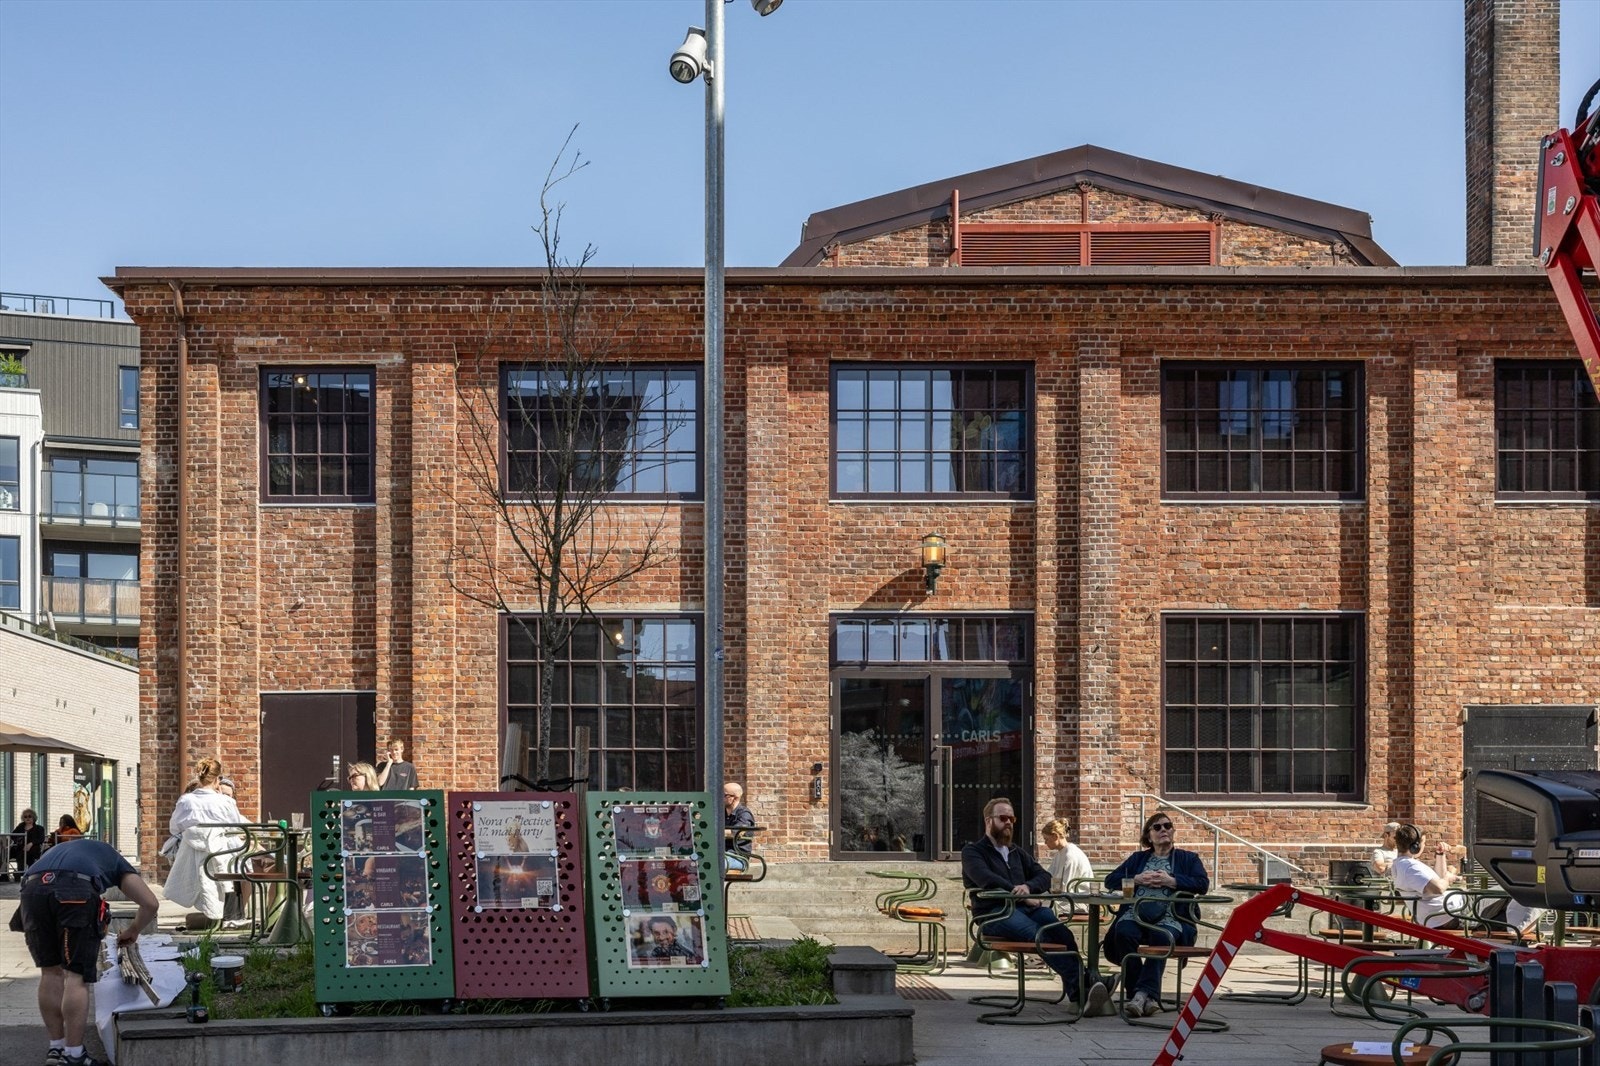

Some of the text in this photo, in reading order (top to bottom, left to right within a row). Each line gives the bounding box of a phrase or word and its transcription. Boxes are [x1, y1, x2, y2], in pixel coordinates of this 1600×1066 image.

[961, 729, 1001, 742] CARLS
[478, 817, 503, 826] Nora
[513, 828, 543, 839] party
